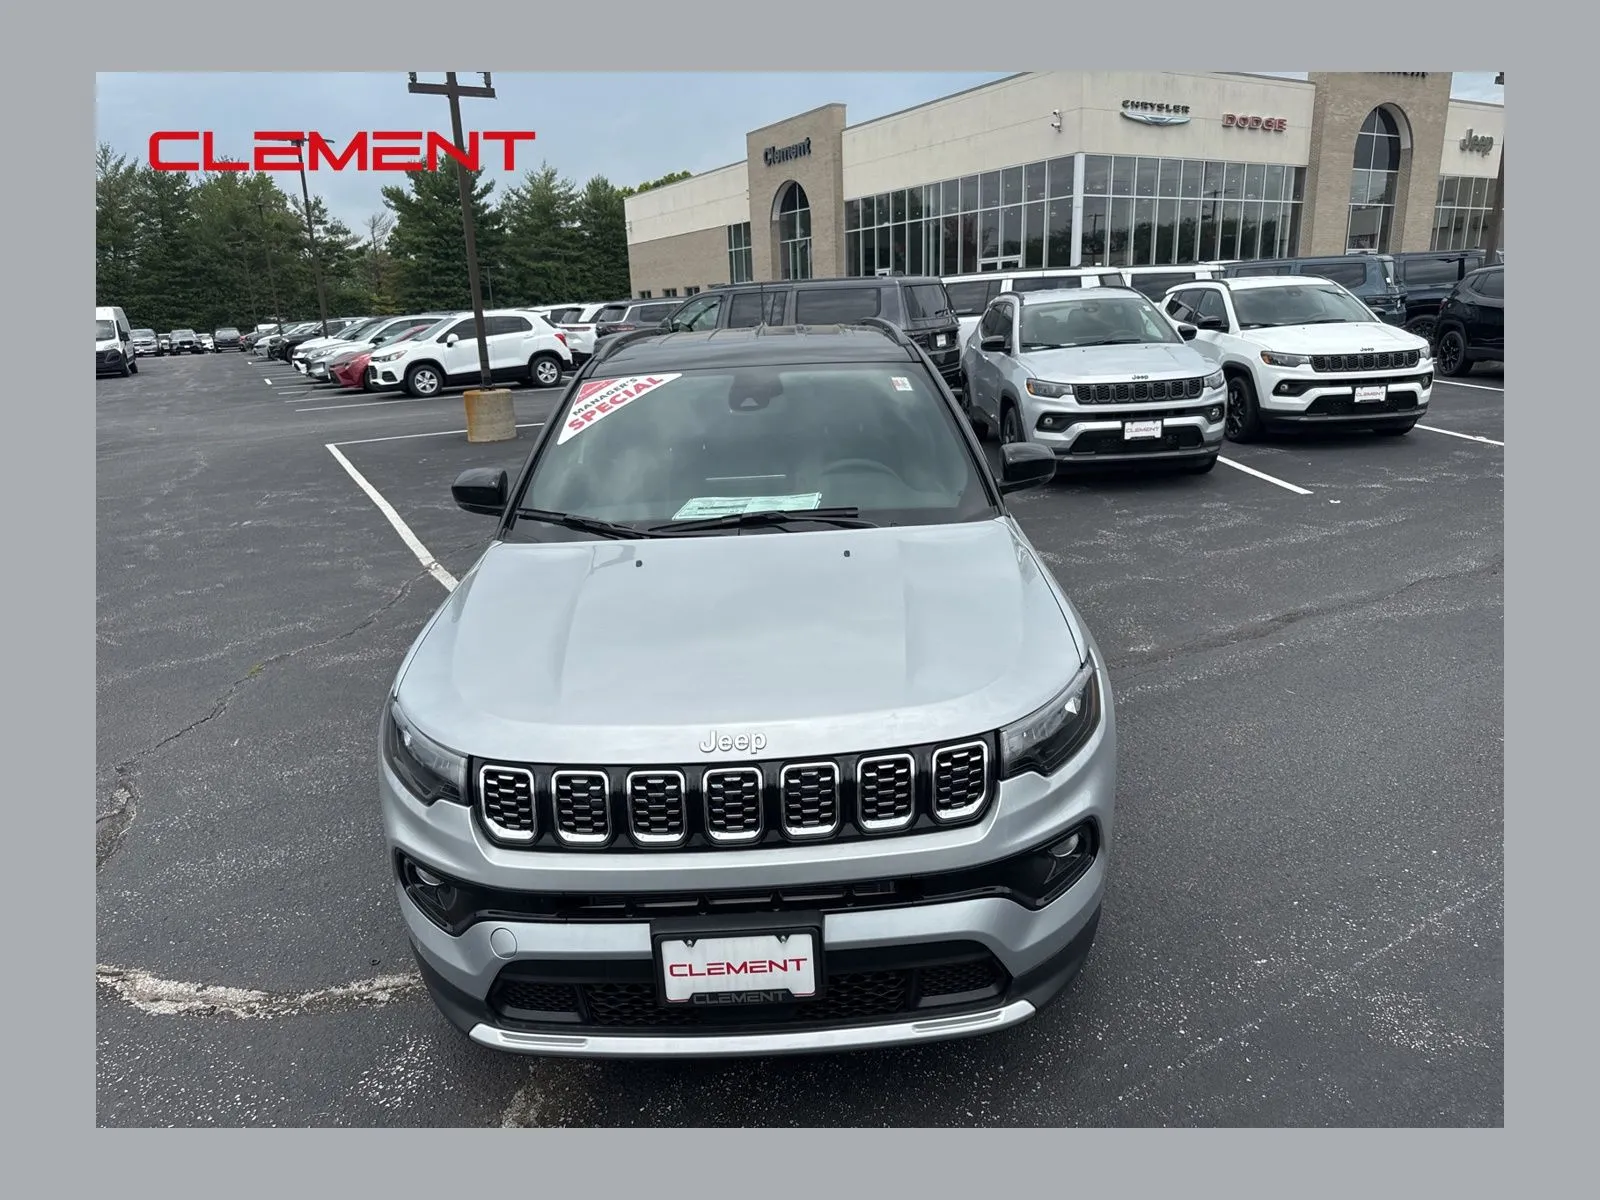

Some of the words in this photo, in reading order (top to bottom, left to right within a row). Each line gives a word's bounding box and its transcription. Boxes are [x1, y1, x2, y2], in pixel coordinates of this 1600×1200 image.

[1121, 100, 1190, 114] CHRYSLER
[1222, 113, 1287, 132] DODGE
[764, 137, 811, 166] Clement
[1459, 129, 1493, 157] Jeep
[568, 377, 663, 430] SPECIAL
[573, 378, 637, 415] MANAGER'S
[699, 730, 767, 754] Jeep
[669, 958, 807, 977] CLEMENT
[693, 990, 787, 1005] CLEMENT
